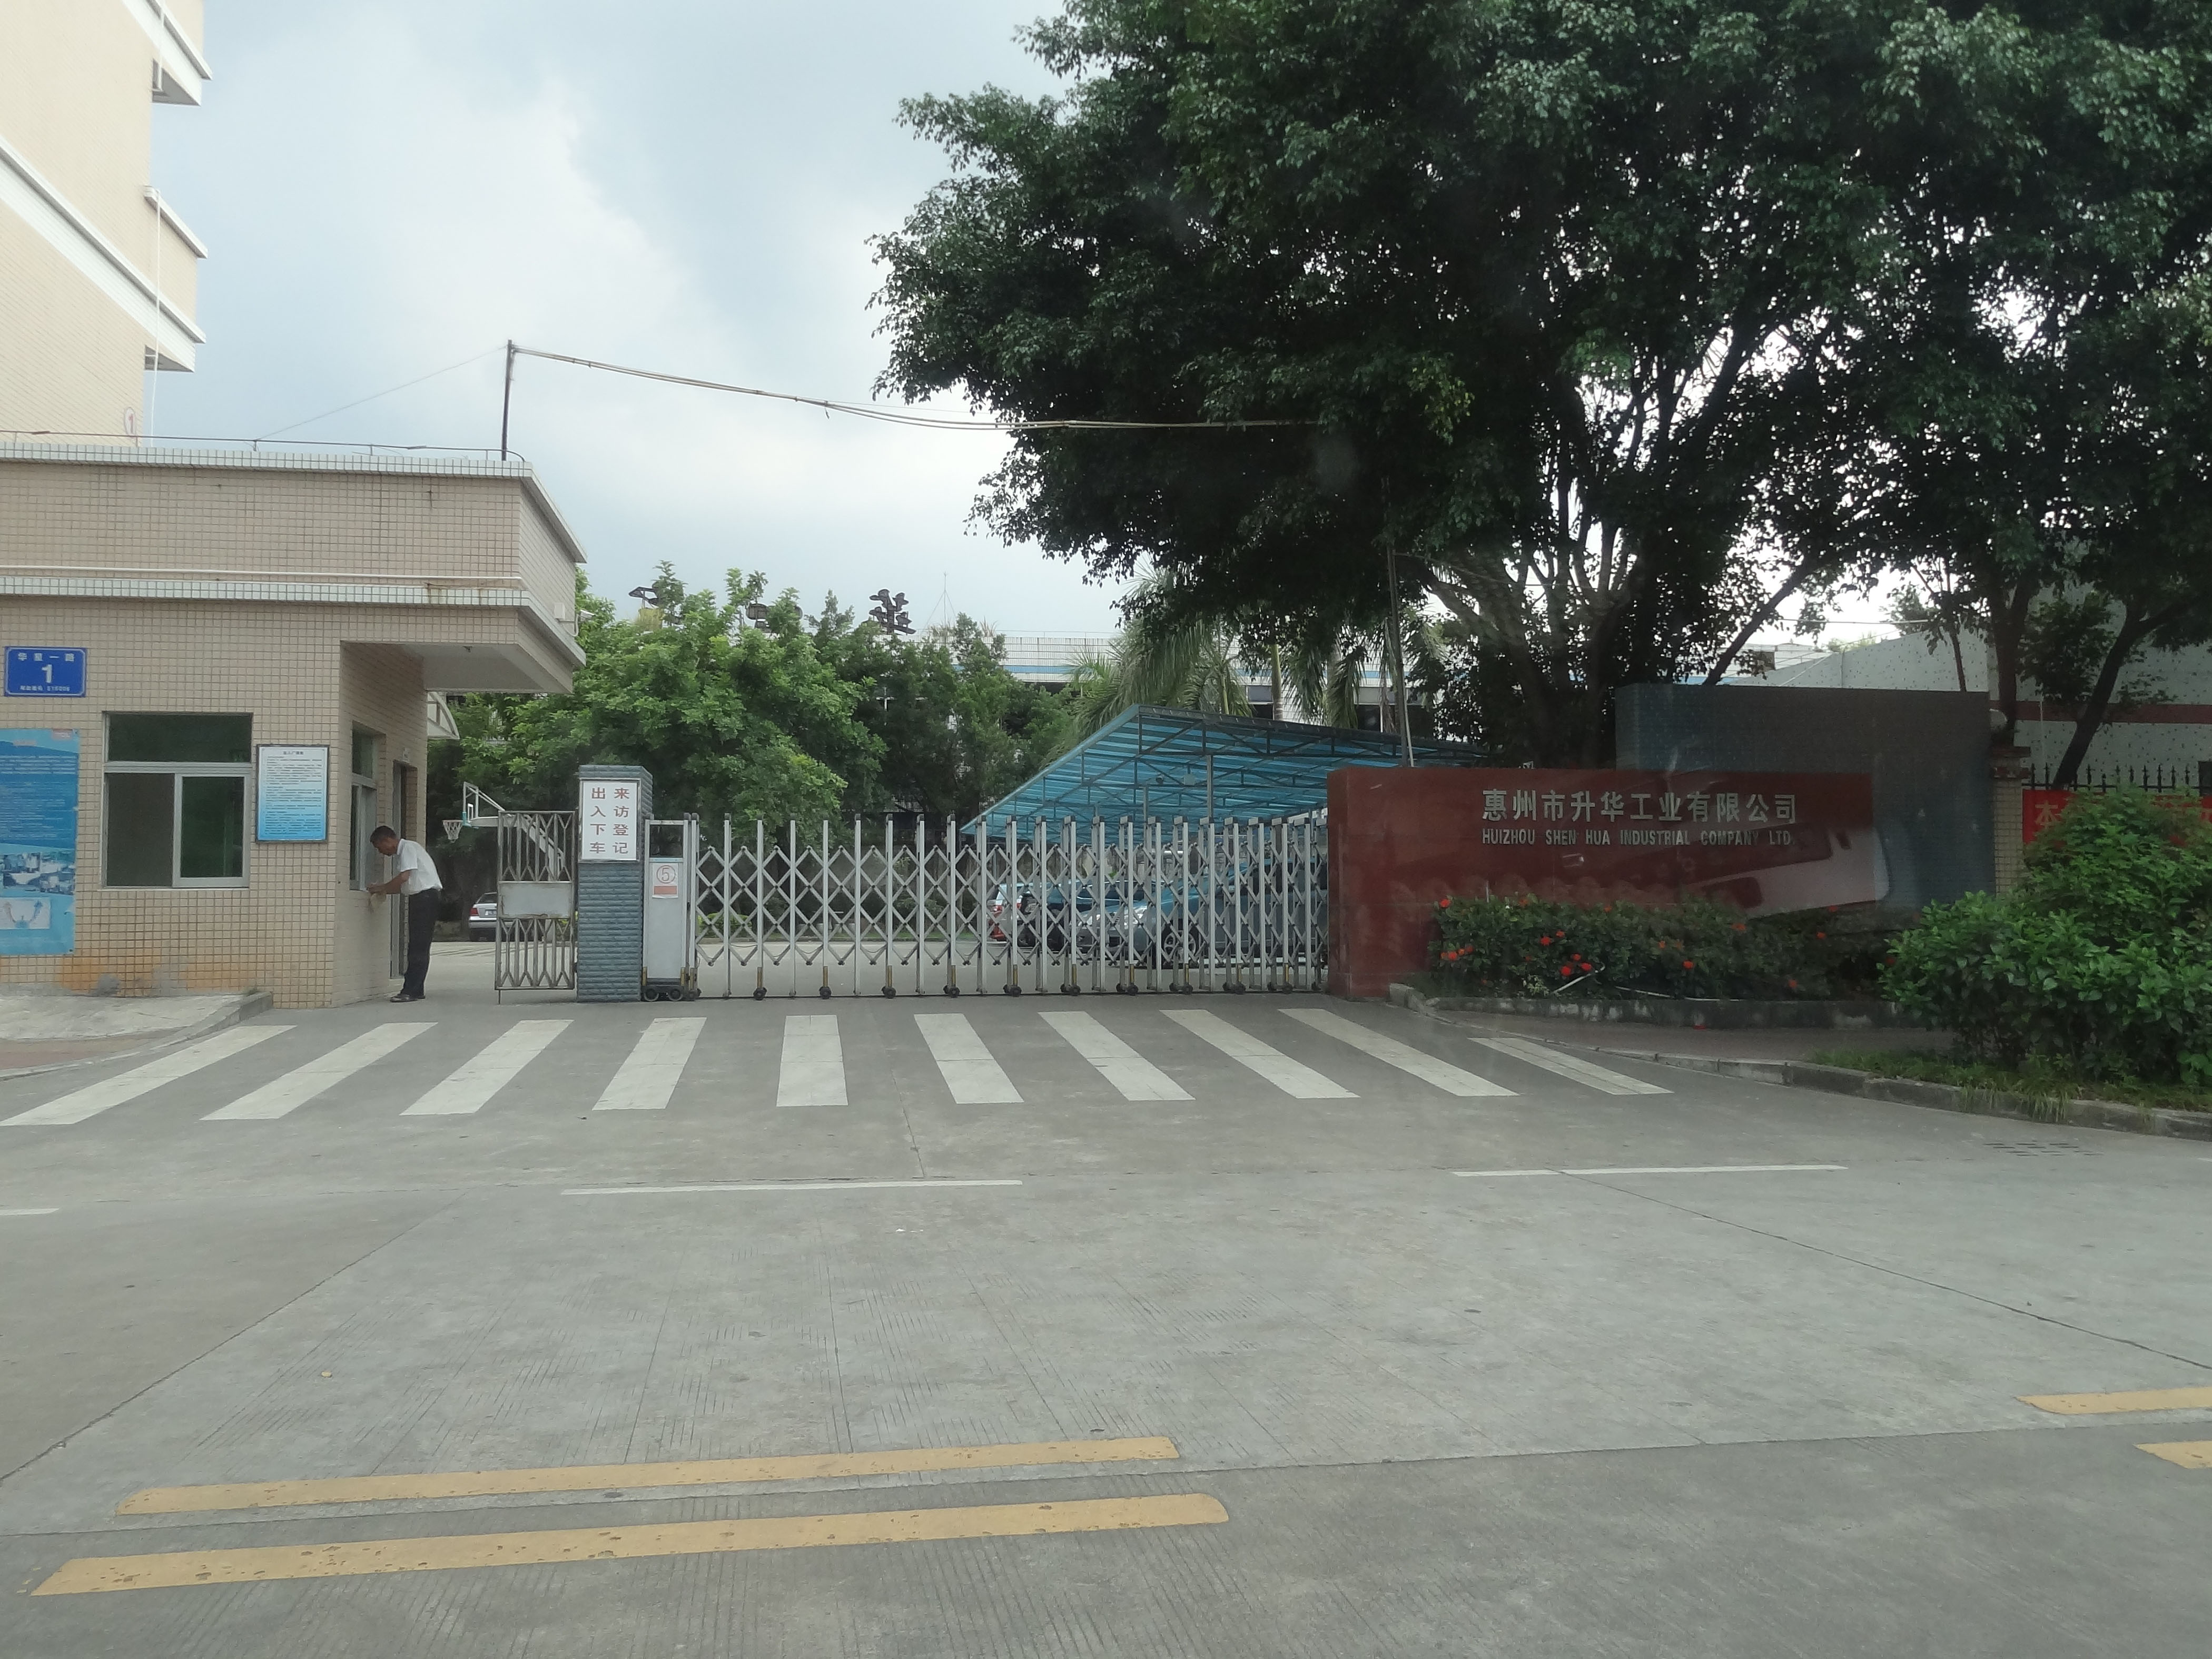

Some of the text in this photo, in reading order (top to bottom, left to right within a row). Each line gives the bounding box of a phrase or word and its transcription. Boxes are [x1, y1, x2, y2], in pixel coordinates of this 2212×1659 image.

[42, 664, 53, 684] 1
[589, 787, 606, 854] 出入下车
[612, 787, 630, 854] 来访登记
[1482, 788, 1796, 824] 惠州市升华工业有限公司
[1482, 828, 1536, 845] HUIZHOU
[1545, 829, 1577, 846] SHEN
[1585, 829, 1611, 846] HUA
[1620, 829, 1690, 846] INDUSTRIAL
[1701, 829, 1759, 846] COMPANY
